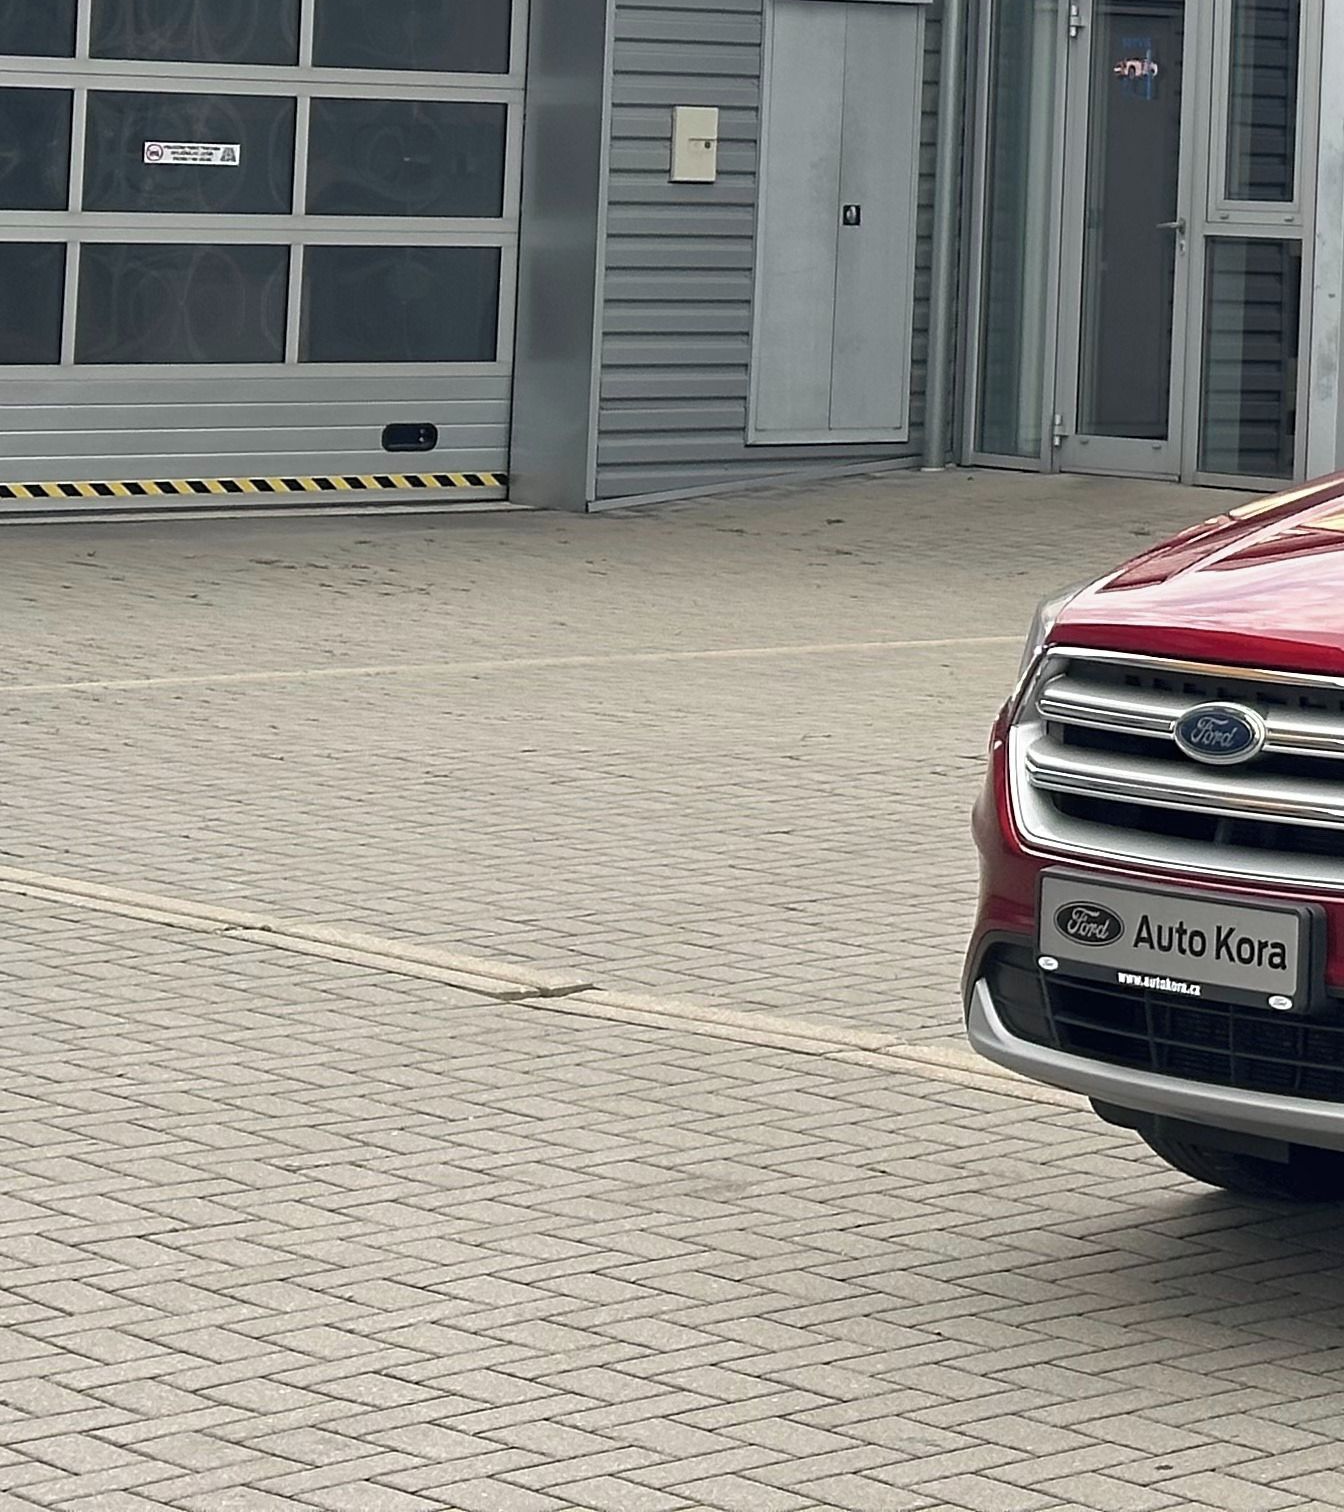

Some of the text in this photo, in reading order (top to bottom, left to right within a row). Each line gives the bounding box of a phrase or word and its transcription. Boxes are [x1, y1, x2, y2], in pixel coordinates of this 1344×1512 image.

[1190, 716, 1238, 748] Ford
[1066, 905, 1112, 939] Ford
[1132, 914, 1288, 971] Auto Kora
